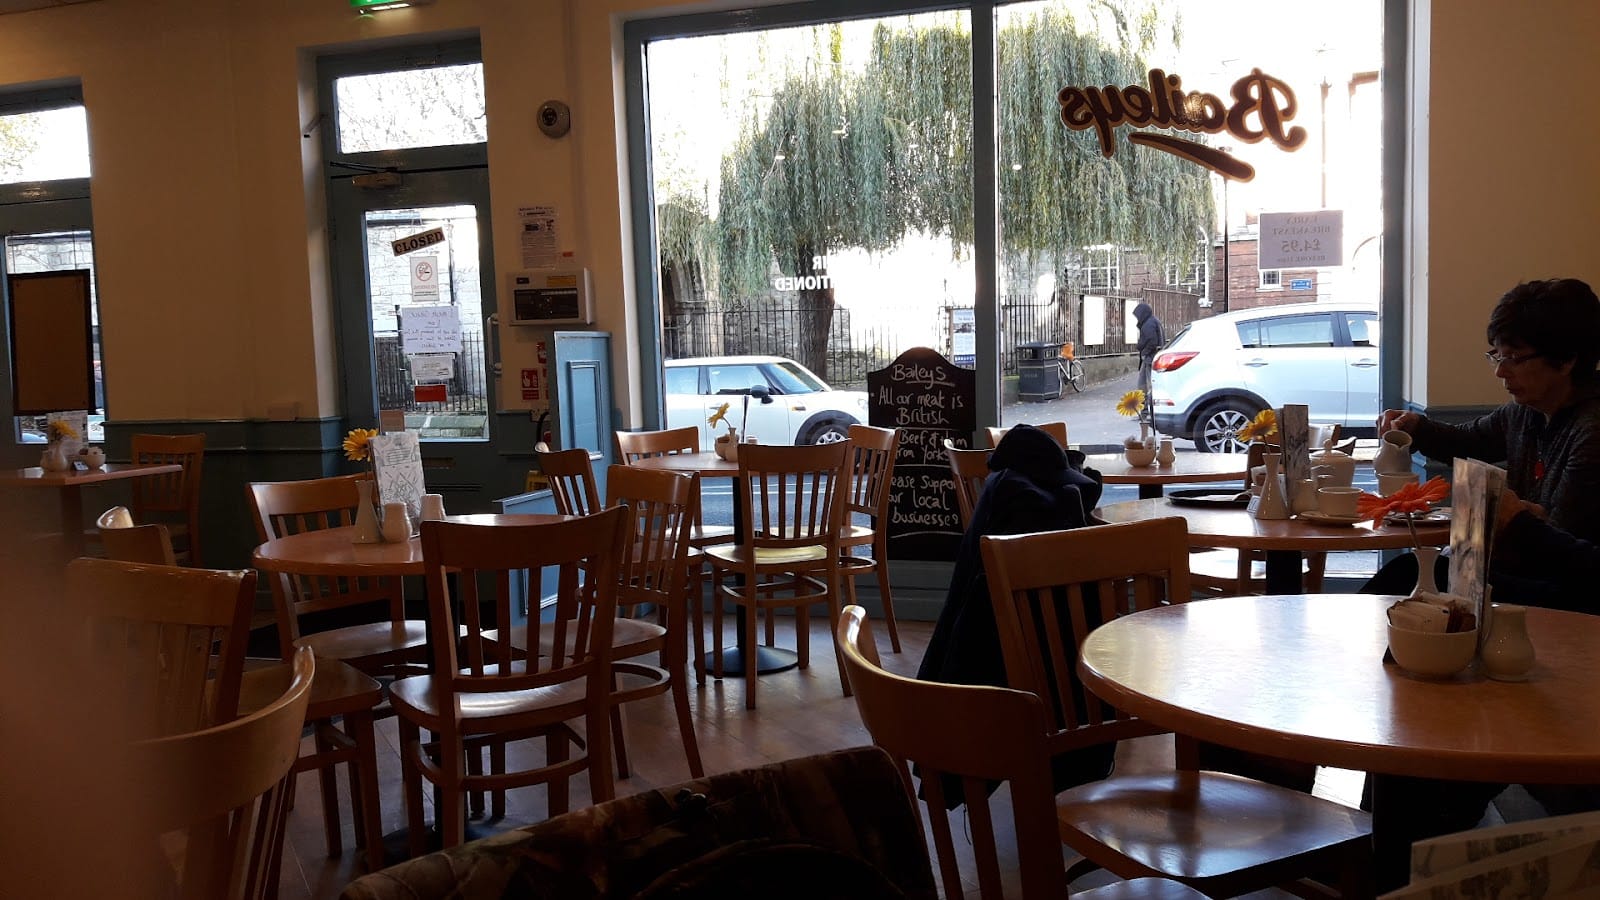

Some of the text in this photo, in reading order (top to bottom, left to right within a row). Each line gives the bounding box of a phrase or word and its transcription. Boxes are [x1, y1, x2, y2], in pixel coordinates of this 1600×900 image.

[394, 231, 444, 254] CLOSED
[891, 363, 947, 390] Baileys
[878, 385, 894, 406] All
[917, 390, 945, 409] meat
[952, 393, 964, 409] is
[896, 406, 950, 425] British
[899, 430, 929, 446] Beef
[891, 476, 915, 489] ease
[912, 489, 951, 511] local
